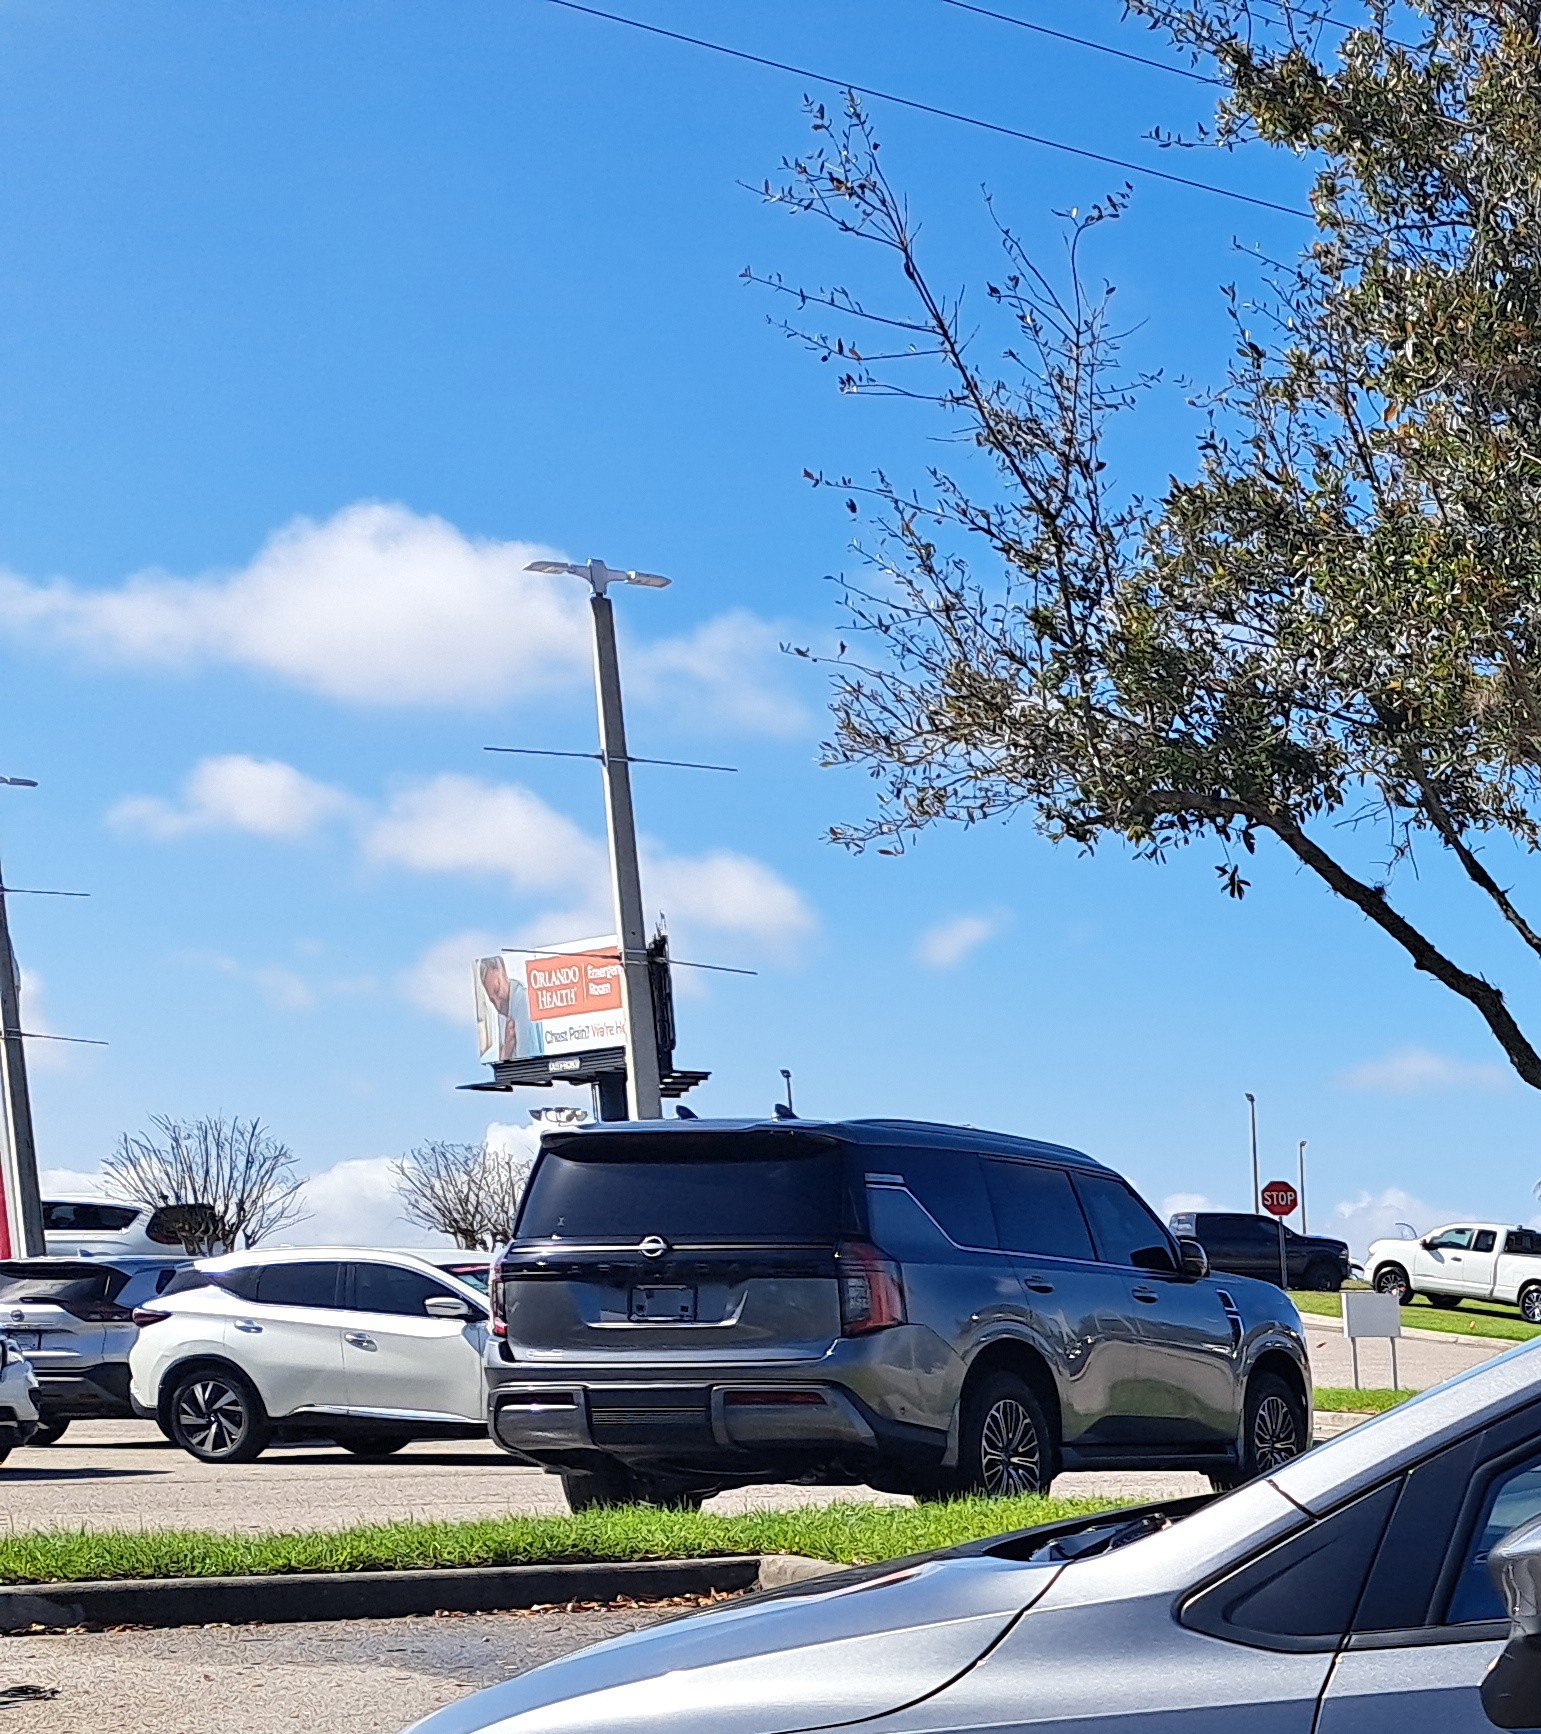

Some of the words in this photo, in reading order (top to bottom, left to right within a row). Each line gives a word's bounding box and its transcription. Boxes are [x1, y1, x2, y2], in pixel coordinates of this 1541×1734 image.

[531, 966, 579, 989] ORLANDO
[587, 964, 624, 979] Emergen
[537, 988, 576, 1009] HEALTH
[1264, 1191, 1295, 1205] STOP
